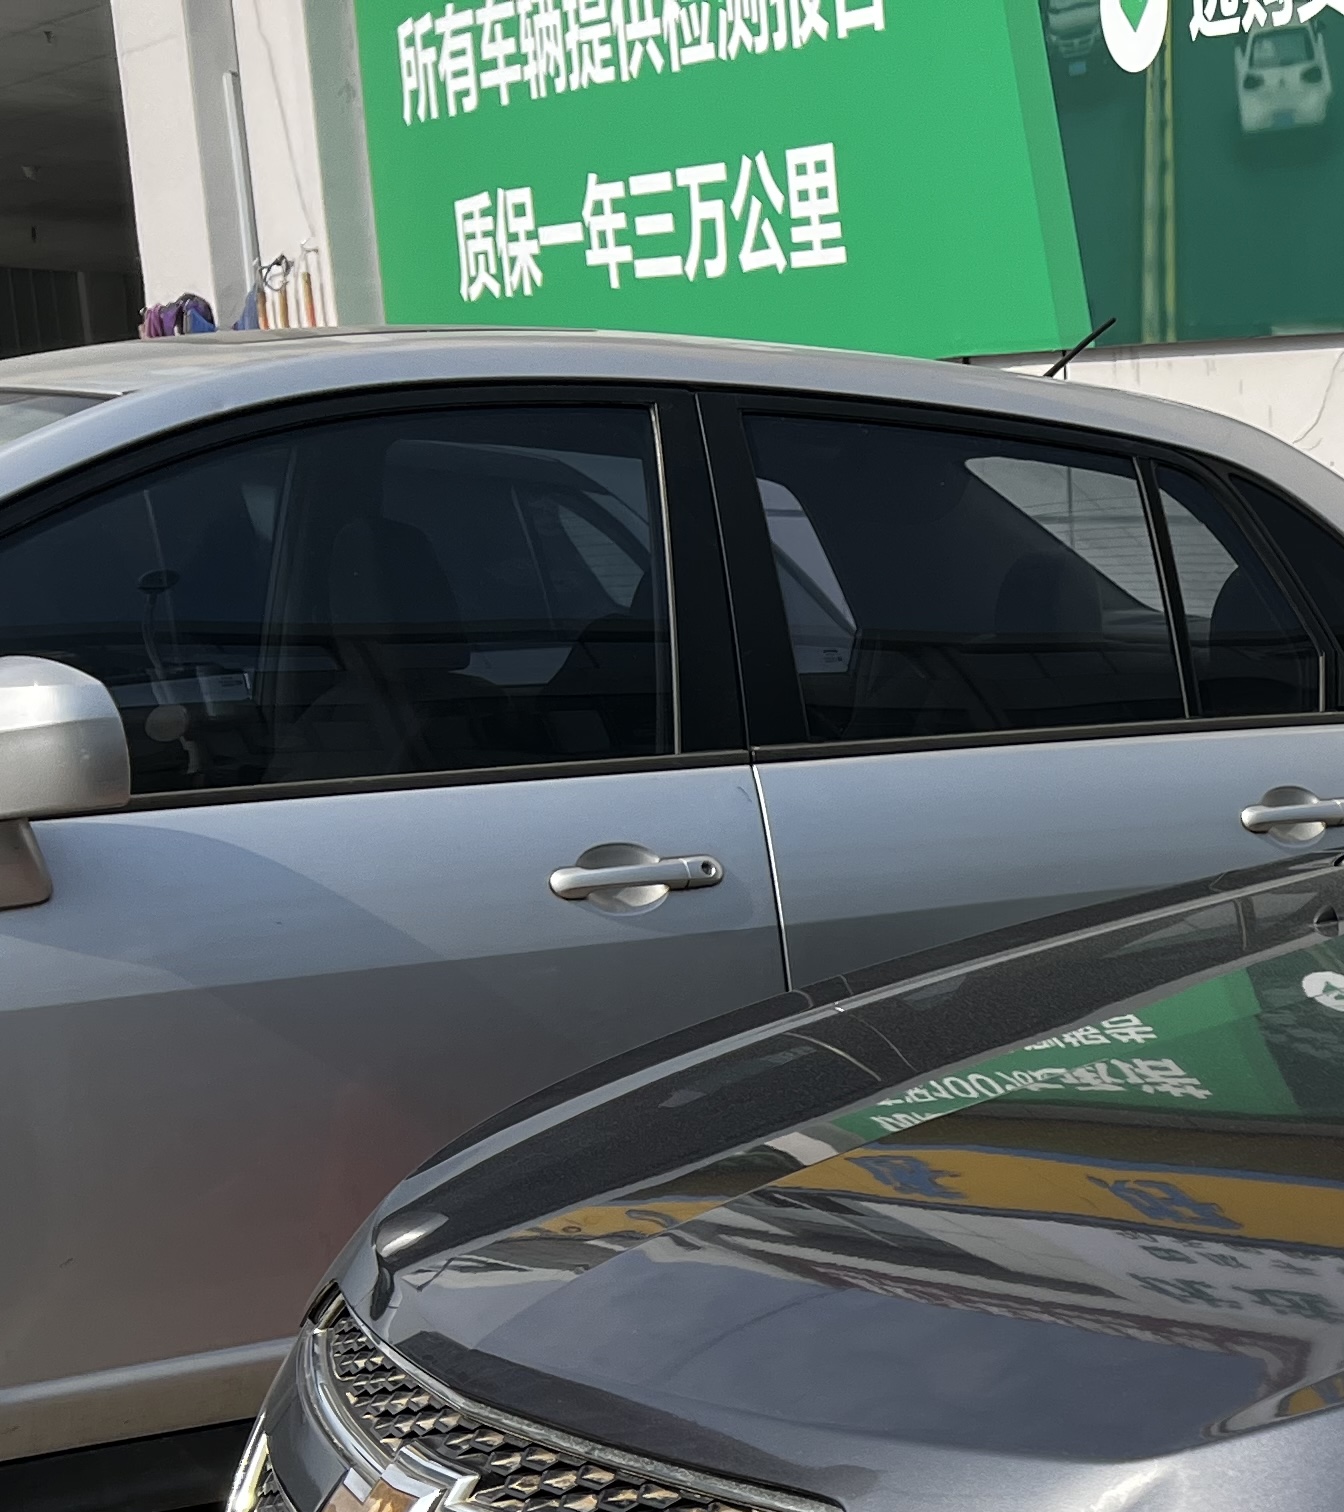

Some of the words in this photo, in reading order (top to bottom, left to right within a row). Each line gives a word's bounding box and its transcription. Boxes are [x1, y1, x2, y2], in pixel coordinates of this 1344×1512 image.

[453, 142, 848, 303] 质保一年三万公里
